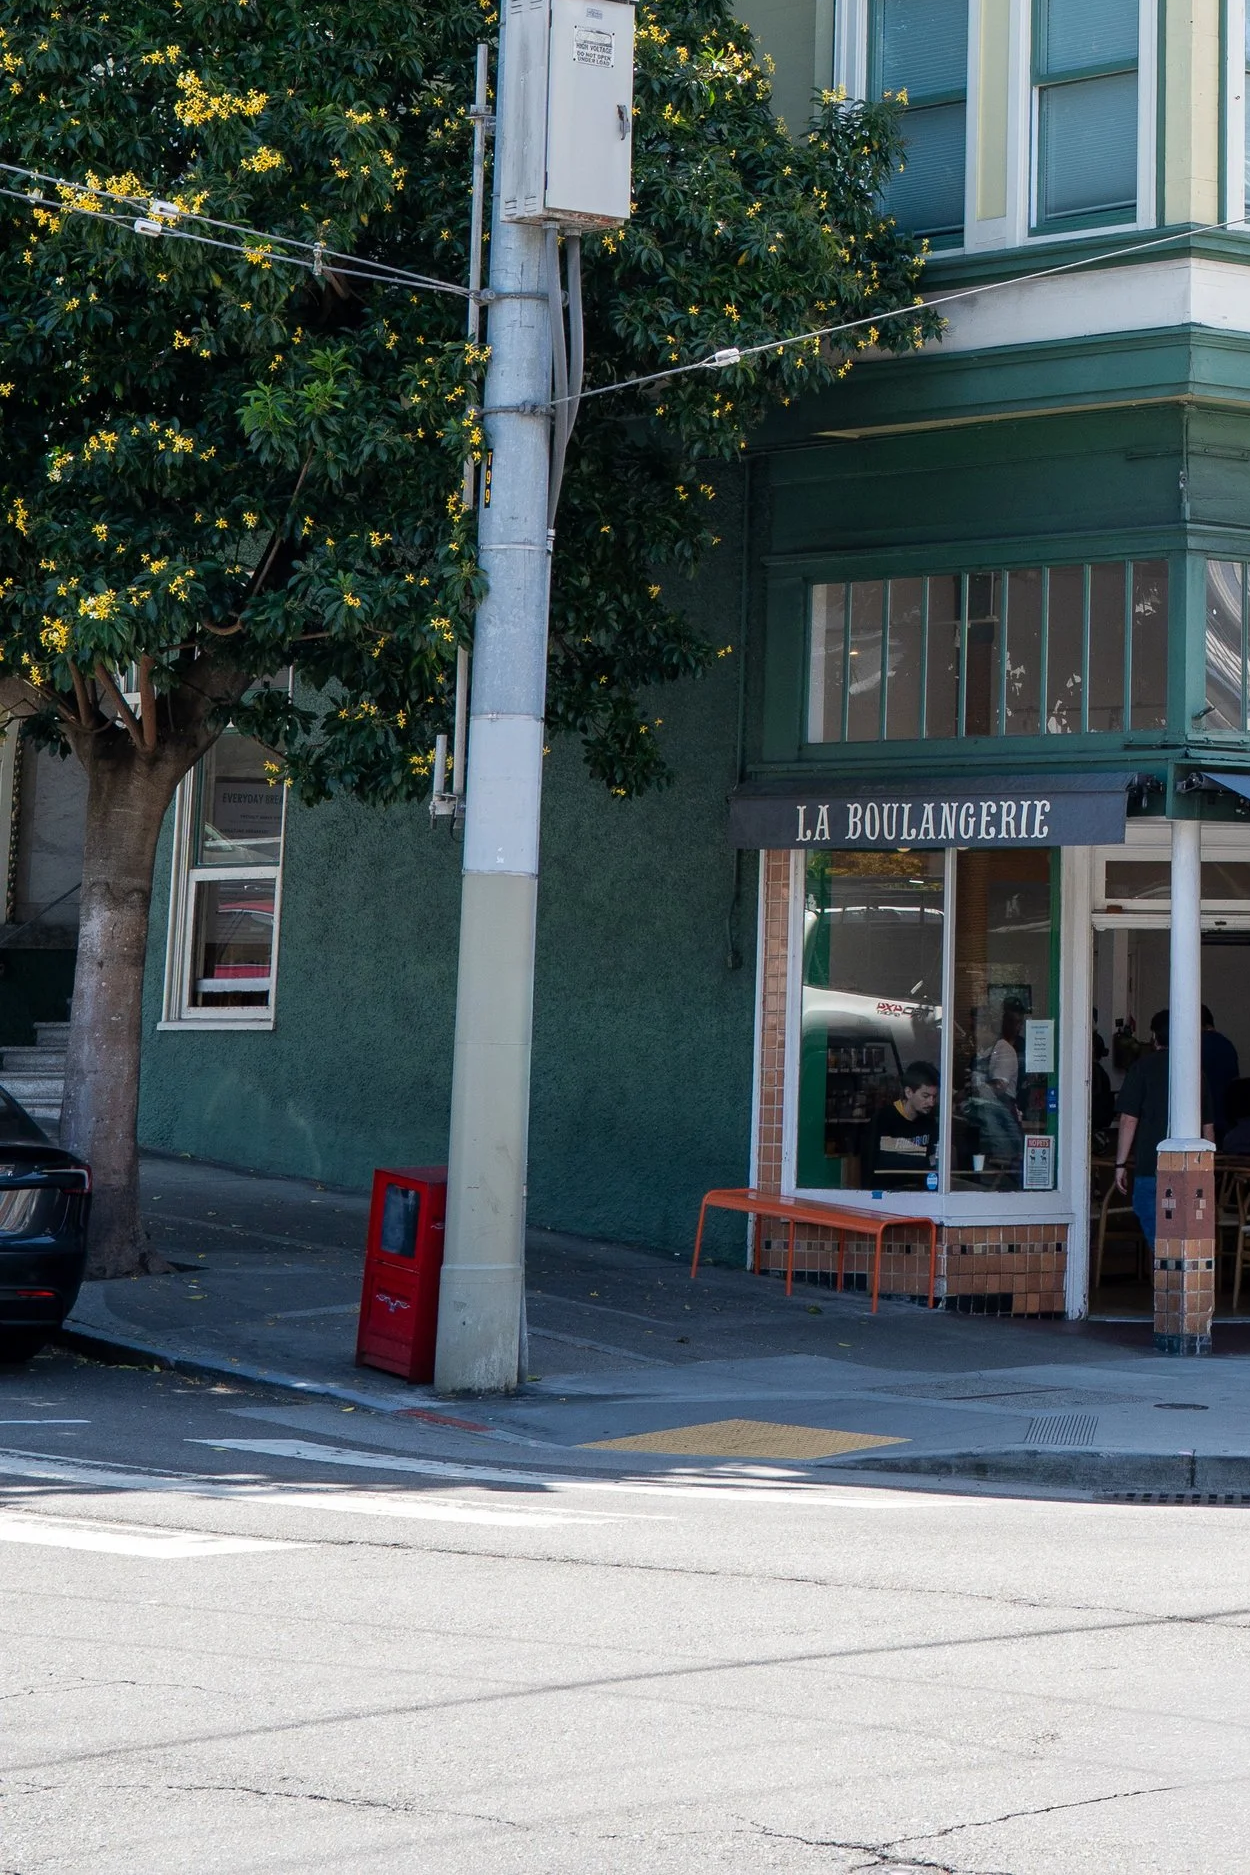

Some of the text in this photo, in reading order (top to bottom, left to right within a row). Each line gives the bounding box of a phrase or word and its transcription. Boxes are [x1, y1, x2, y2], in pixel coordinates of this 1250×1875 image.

[590, 45, 612, 54] VOLTAGE
[485, 452, 493, 504] T99
[222, 792, 264, 805] EVERYDAY
[796, 800, 1051, 841] LA BOULANGERIE
[1028, 1139, 1049, 1147] NO PETS
